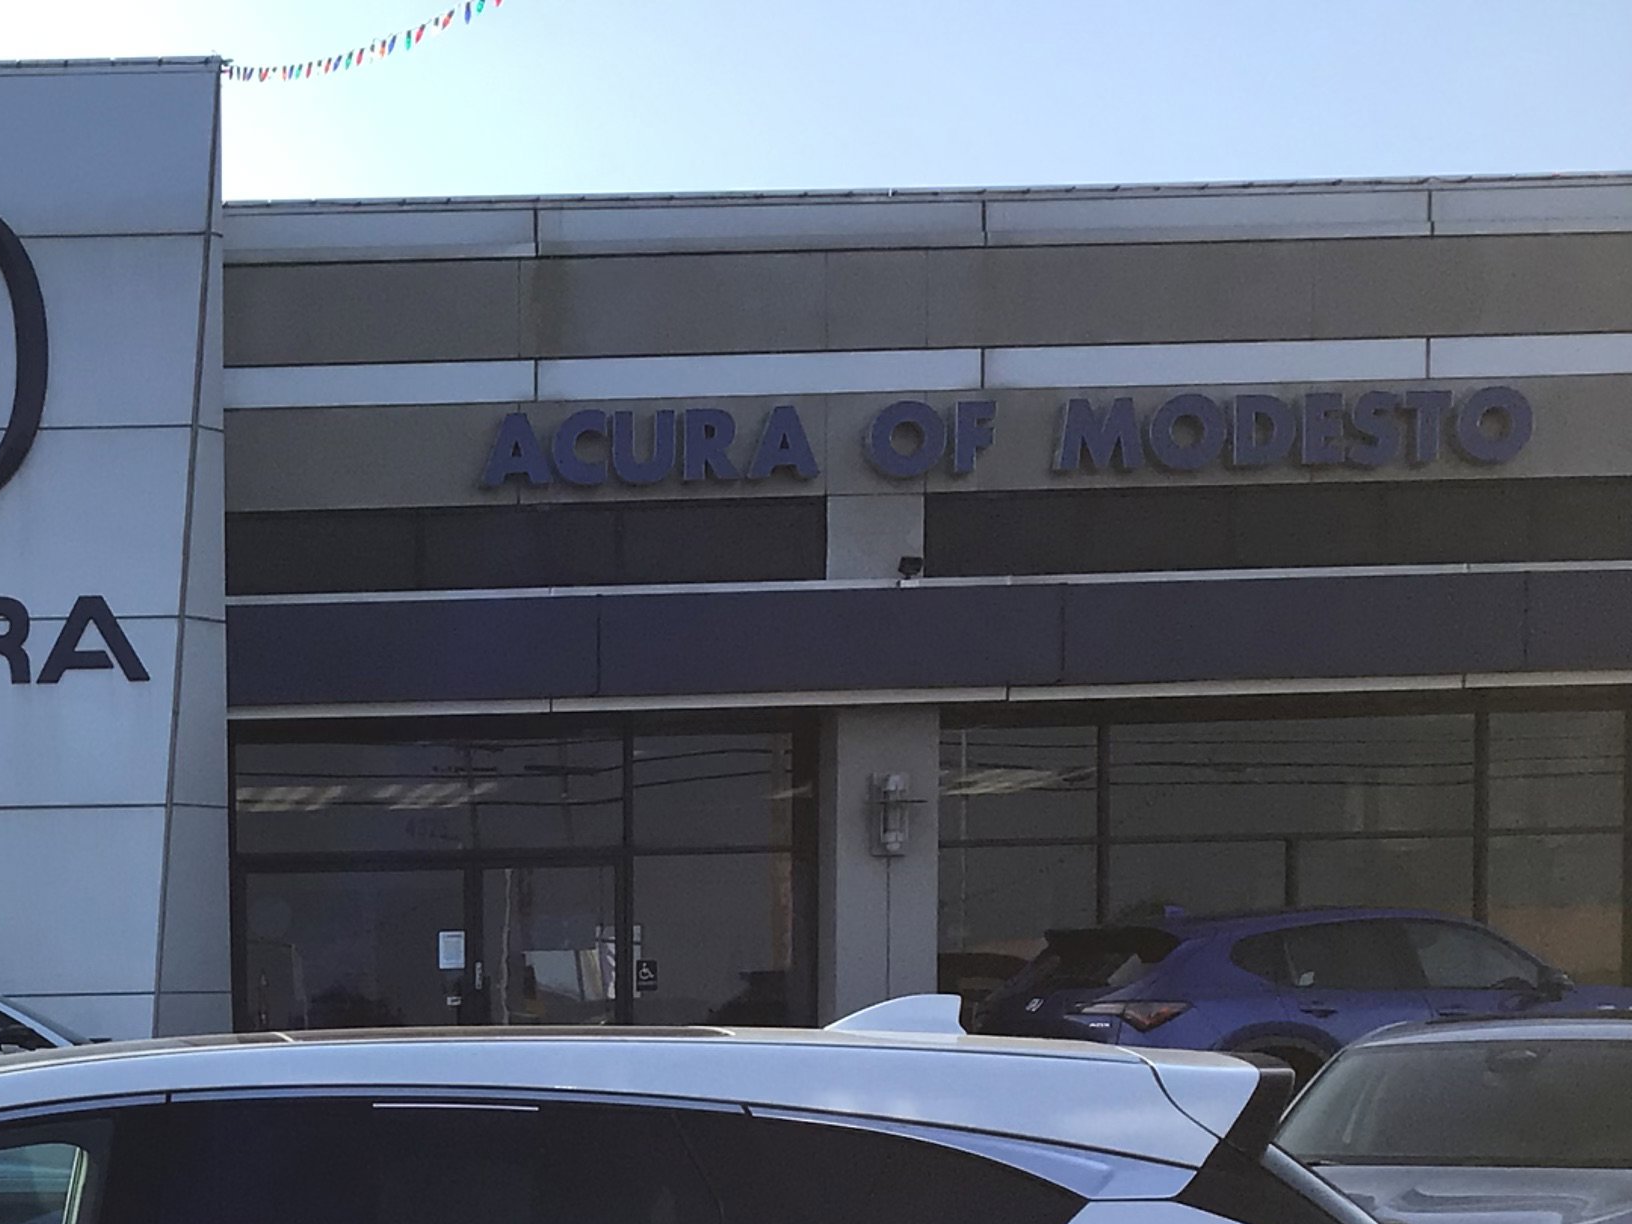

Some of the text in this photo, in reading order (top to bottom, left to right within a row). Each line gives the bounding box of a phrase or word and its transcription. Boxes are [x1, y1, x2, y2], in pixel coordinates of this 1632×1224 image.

[482, 385, 1535, 486] ACURA OF MODESTO
